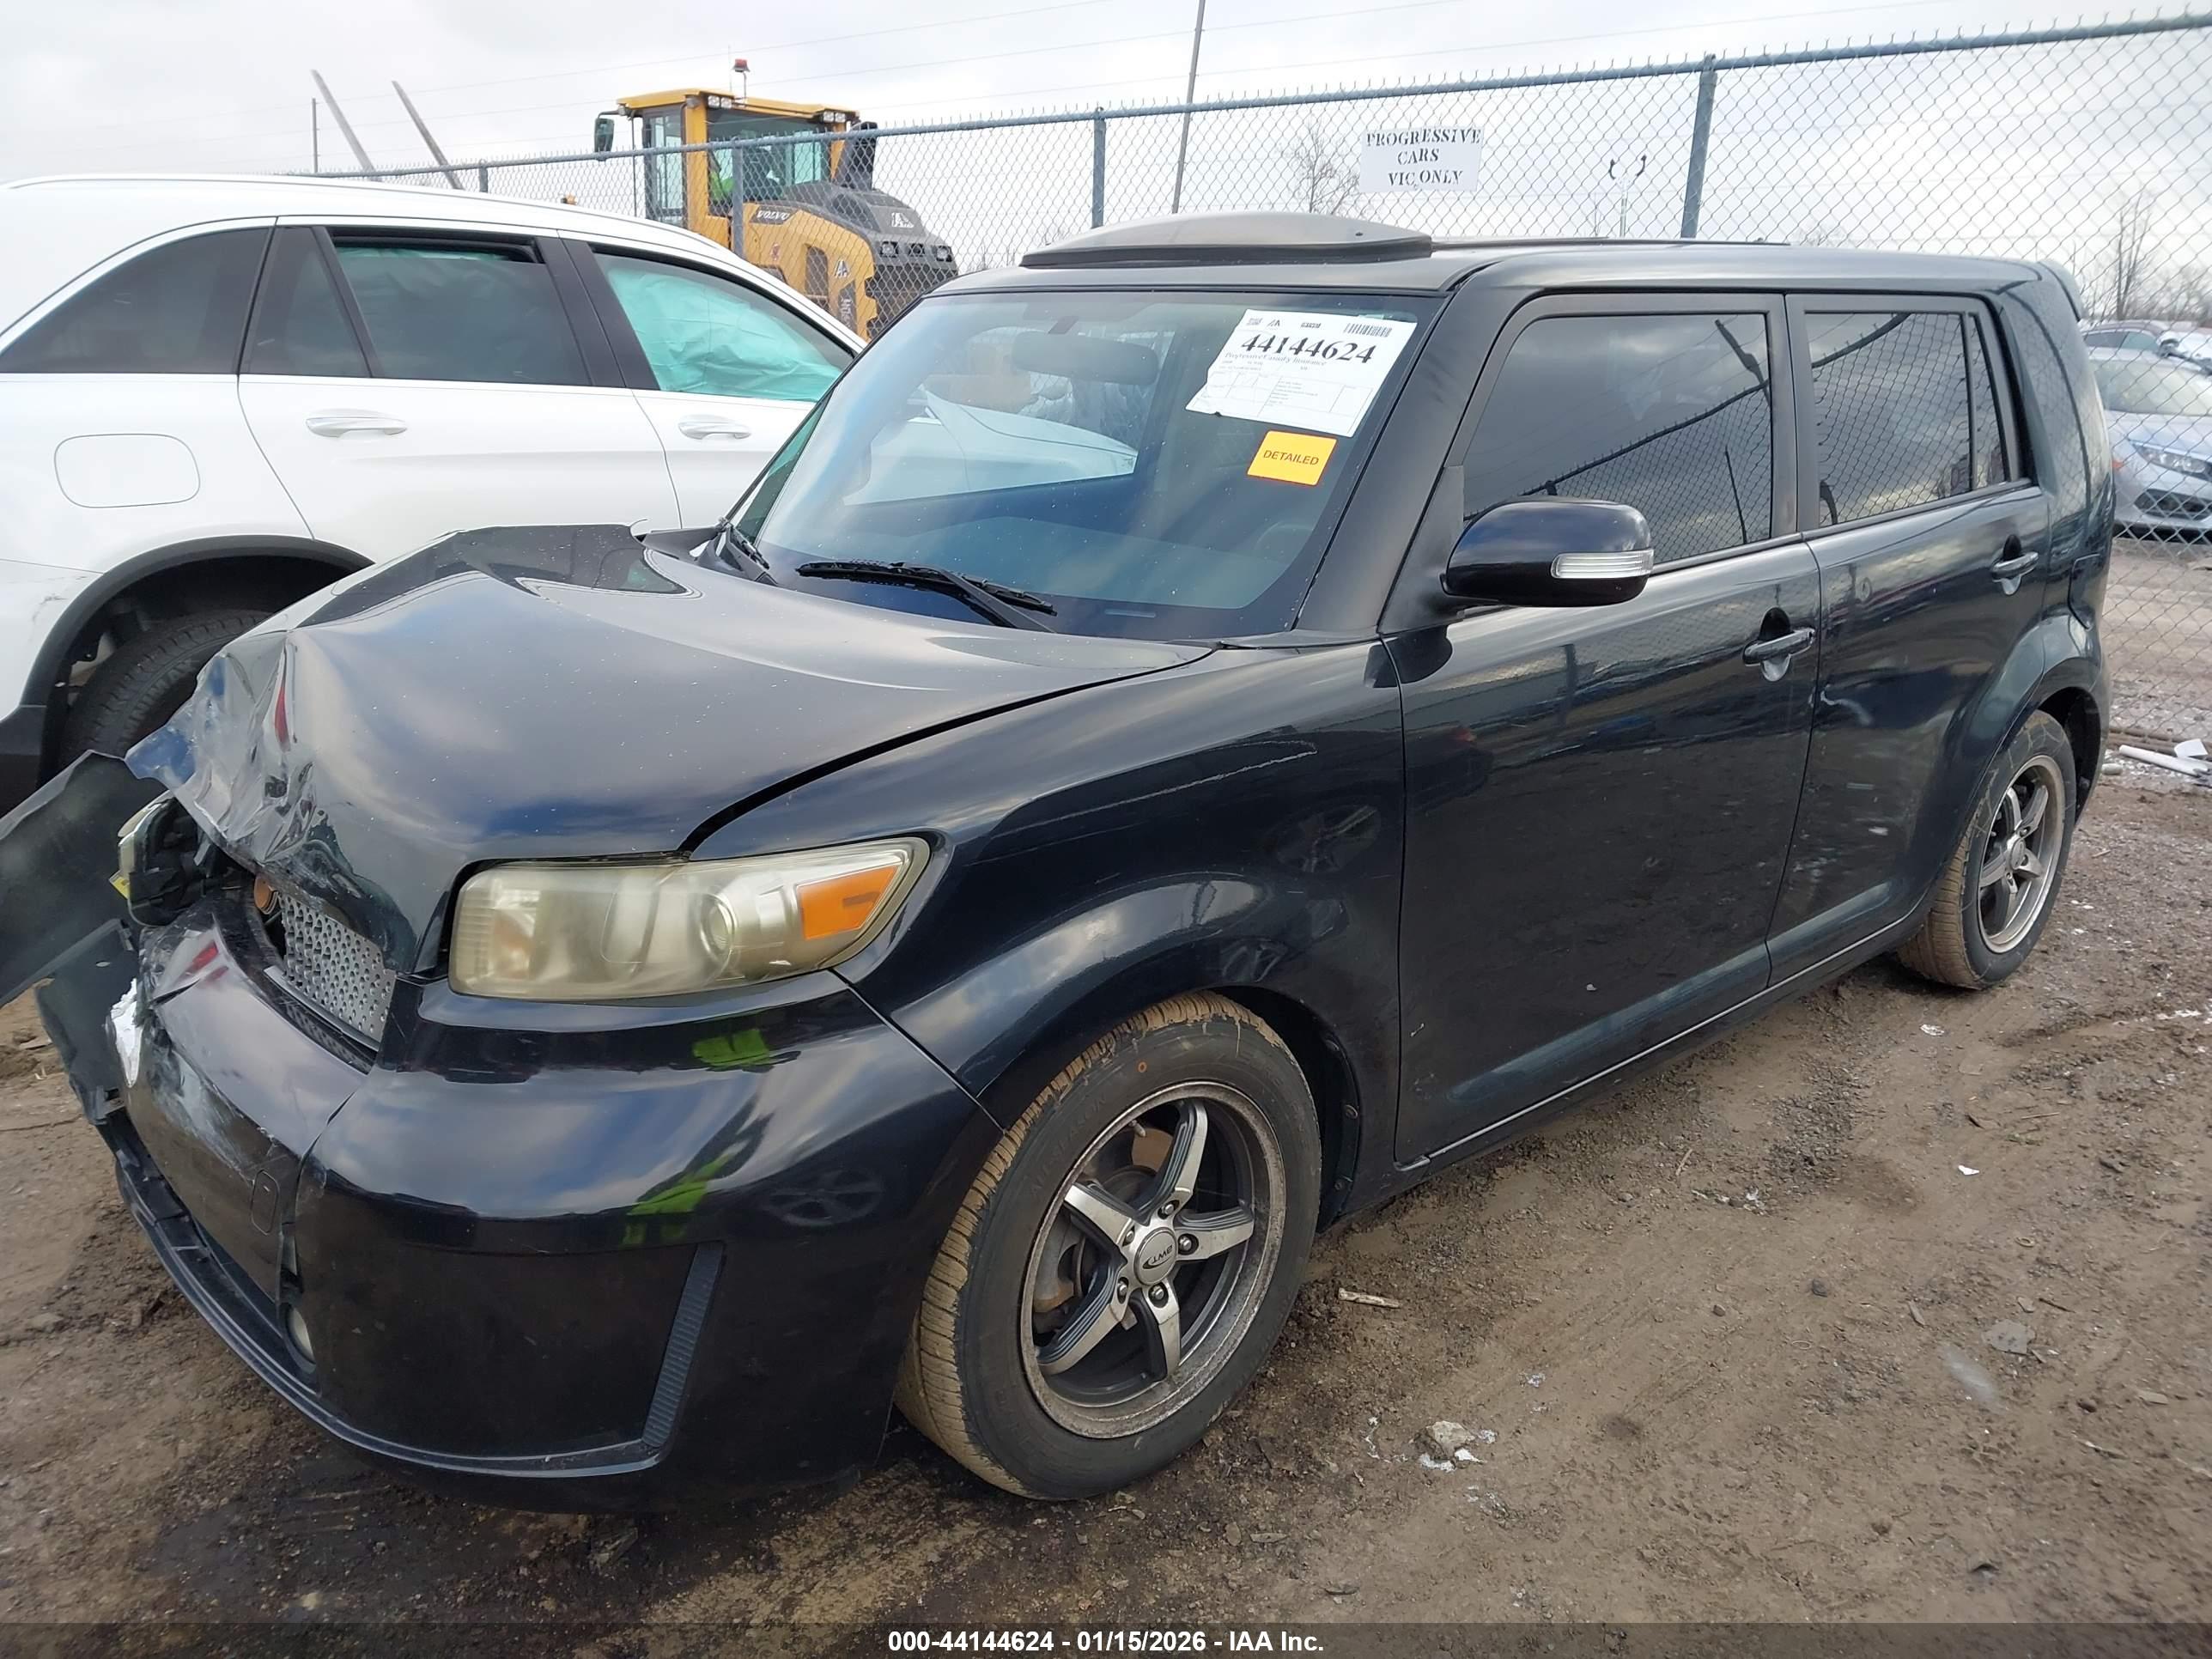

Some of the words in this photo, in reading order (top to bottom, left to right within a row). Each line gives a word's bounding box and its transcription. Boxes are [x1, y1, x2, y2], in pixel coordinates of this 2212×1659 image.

[1366, 128, 1481, 147] PROGRESSIVE
[1397, 148, 1439, 165] CARS
[1419, 169, 1463, 185] ONLY
[757, 210, 790, 221] VOLVO
[1241, 333, 1377, 364] 44144624
[1263, 449, 1320, 465] DETAILED
